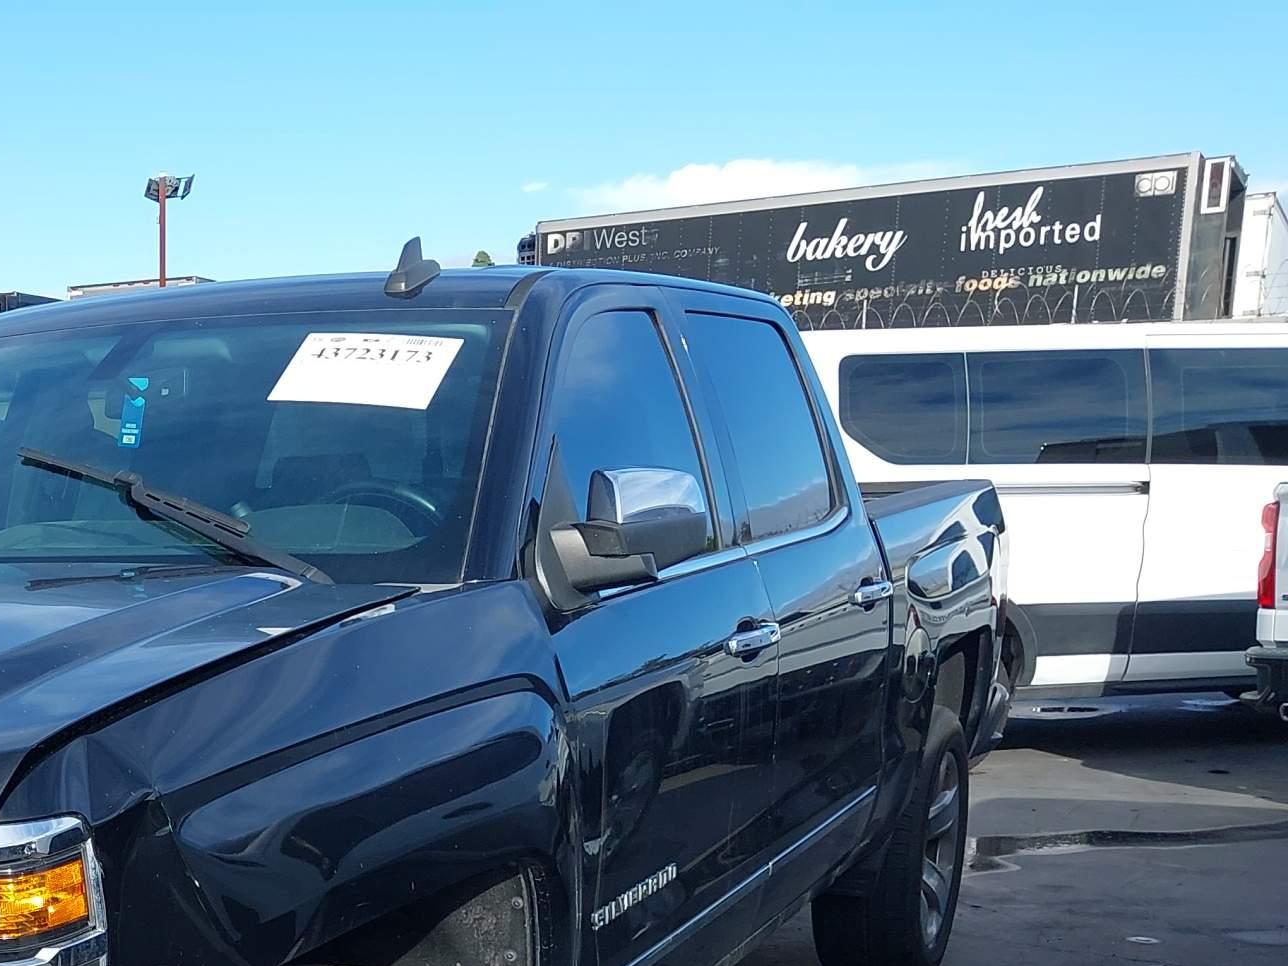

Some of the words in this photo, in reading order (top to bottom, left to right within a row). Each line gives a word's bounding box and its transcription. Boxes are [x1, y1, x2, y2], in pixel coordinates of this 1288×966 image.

[968, 186, 1044, 250] fresh
[594, 226, 646, 249] West
[786, 218, 908, 271] bakery
[960, 214, 1102, 254] imported
[981, 264, 1063, 279] DELICIOUS
[1028, 263, 1166, 288] nationwide
[311, 346, 433, 364] 43723173
